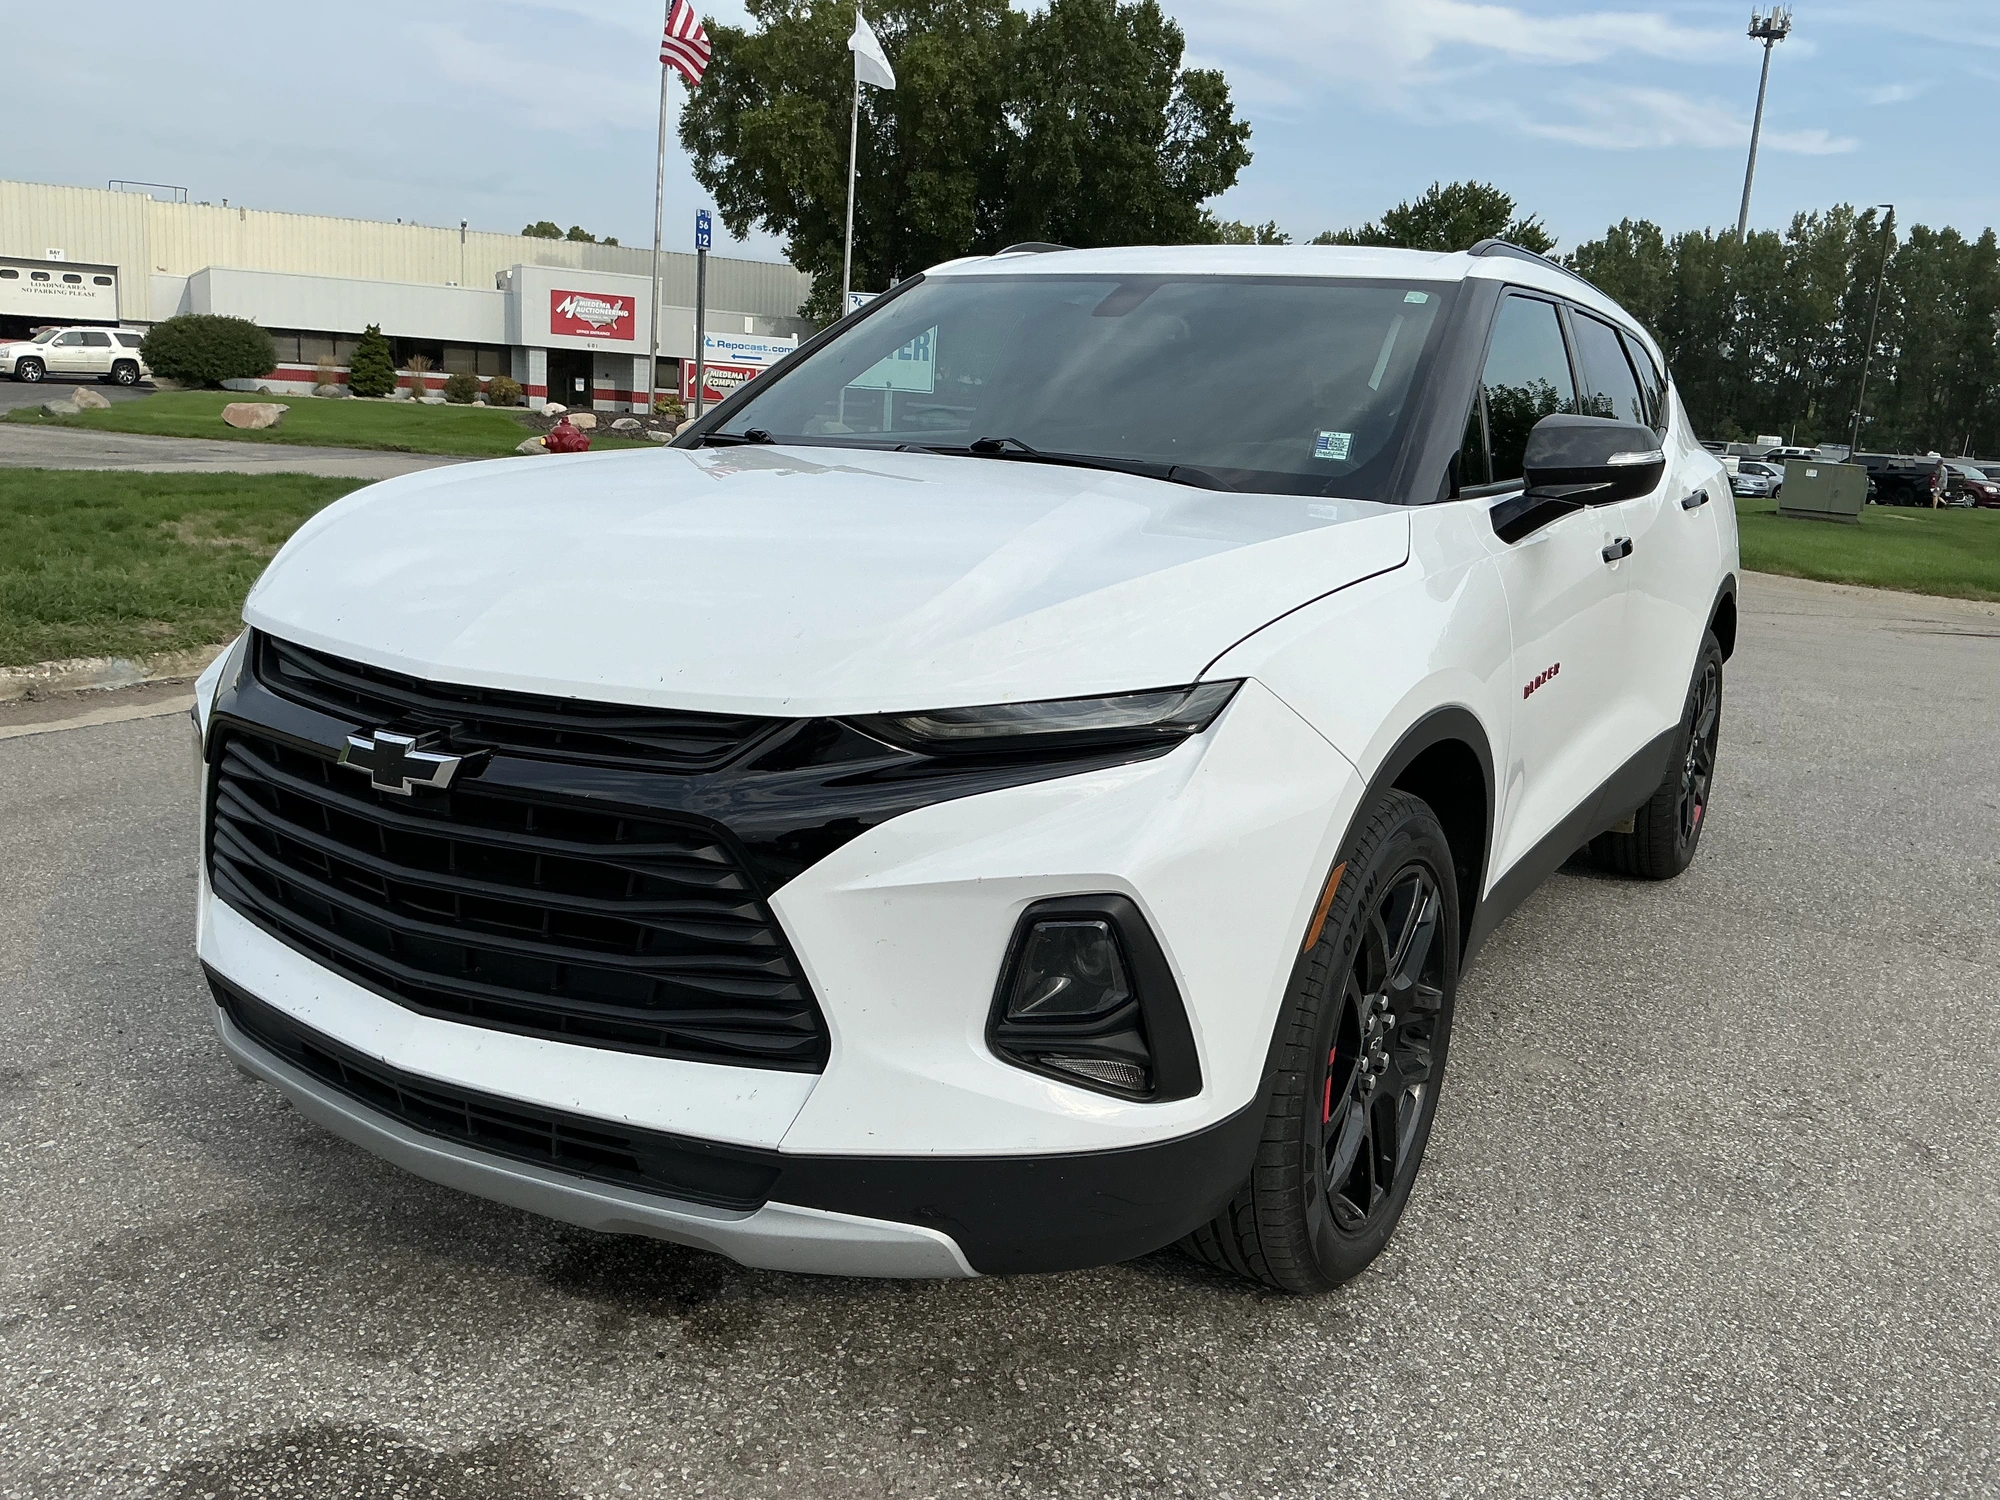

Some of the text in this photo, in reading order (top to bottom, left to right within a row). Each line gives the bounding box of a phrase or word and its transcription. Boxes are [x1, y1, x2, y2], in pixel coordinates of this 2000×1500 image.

[699, 220, 709, 230] 56
[697, 233, 709, 246] 12
[578, 300, 611, 309] MIEDEMA
[576, 307, 629, 317] AUCTIONEERING
[717, 340, 795, 353] Repocast.com
[710, 370, 744, 380] MIEDEMA
[1343, 870, 1378, 957] OTANI
